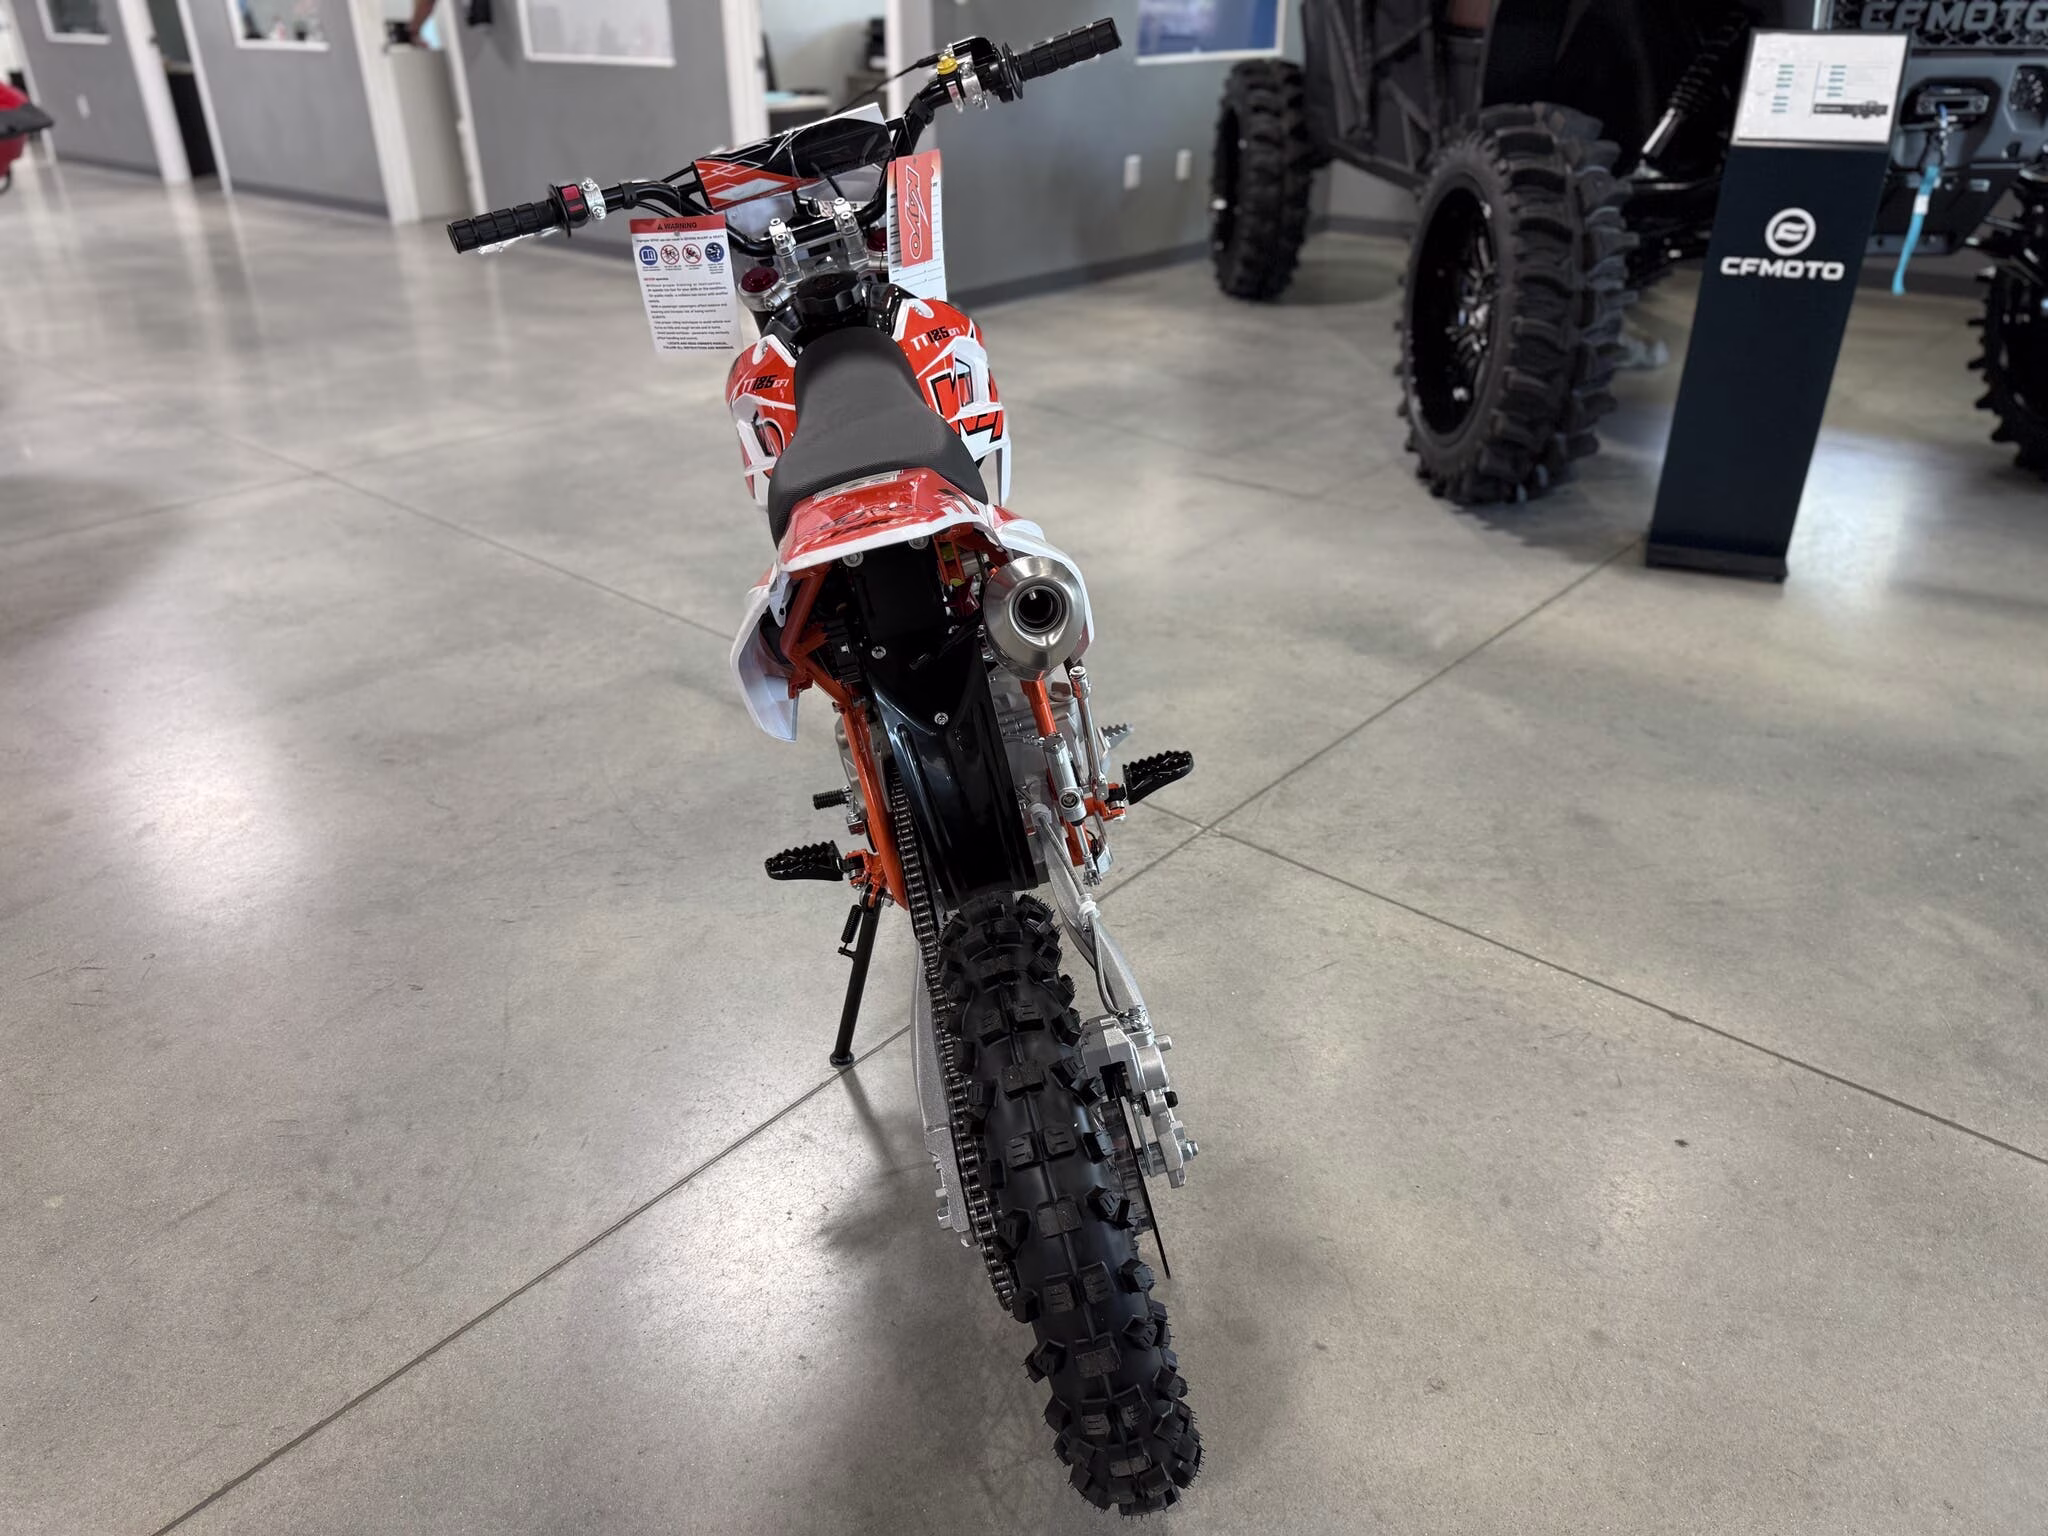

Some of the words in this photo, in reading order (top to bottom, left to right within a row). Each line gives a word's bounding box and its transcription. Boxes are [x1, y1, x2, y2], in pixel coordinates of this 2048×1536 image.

[1860, 1, 2048, 32] CFMOTO
[663, 222, 698, 231] WARNING
[1720, 257, 1845, 281] CFMOTO
